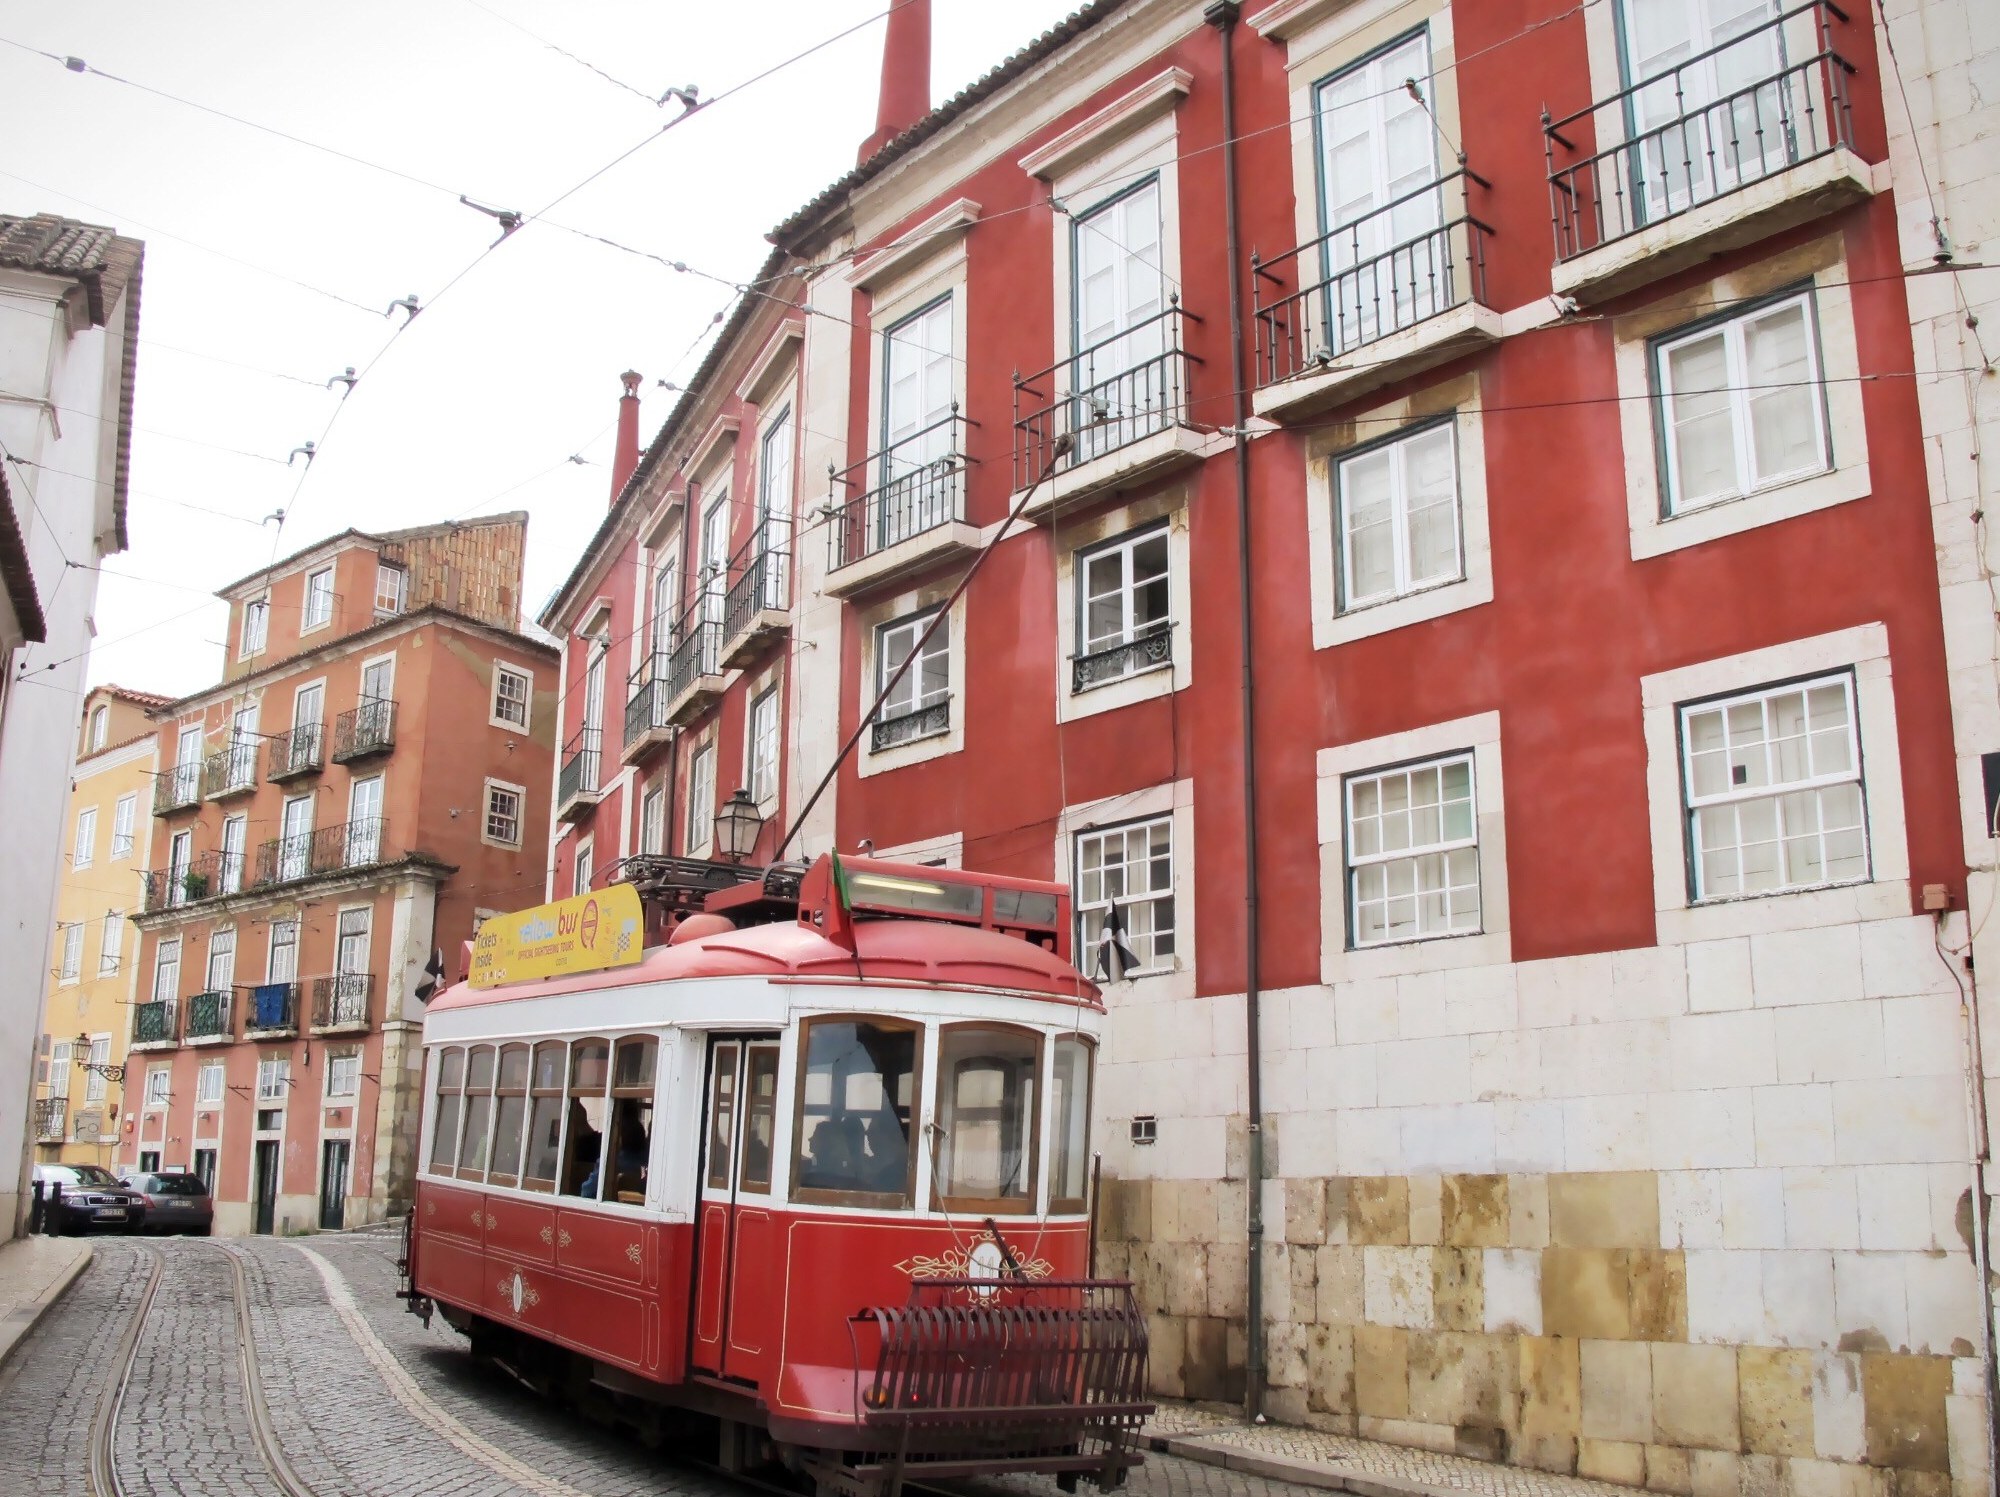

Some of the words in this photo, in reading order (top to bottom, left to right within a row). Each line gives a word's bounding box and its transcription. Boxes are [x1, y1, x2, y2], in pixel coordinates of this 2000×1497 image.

[558, 906, 578, 936] bus
[477, 932, 497, 949] Tickets
[518, 949, 533, 960] OFFICIAL
[535, 944, 558, 957] SIGHTSEEING
[561, 940, 574, 952] TOURS
[475, 951, 492, 968] inside
